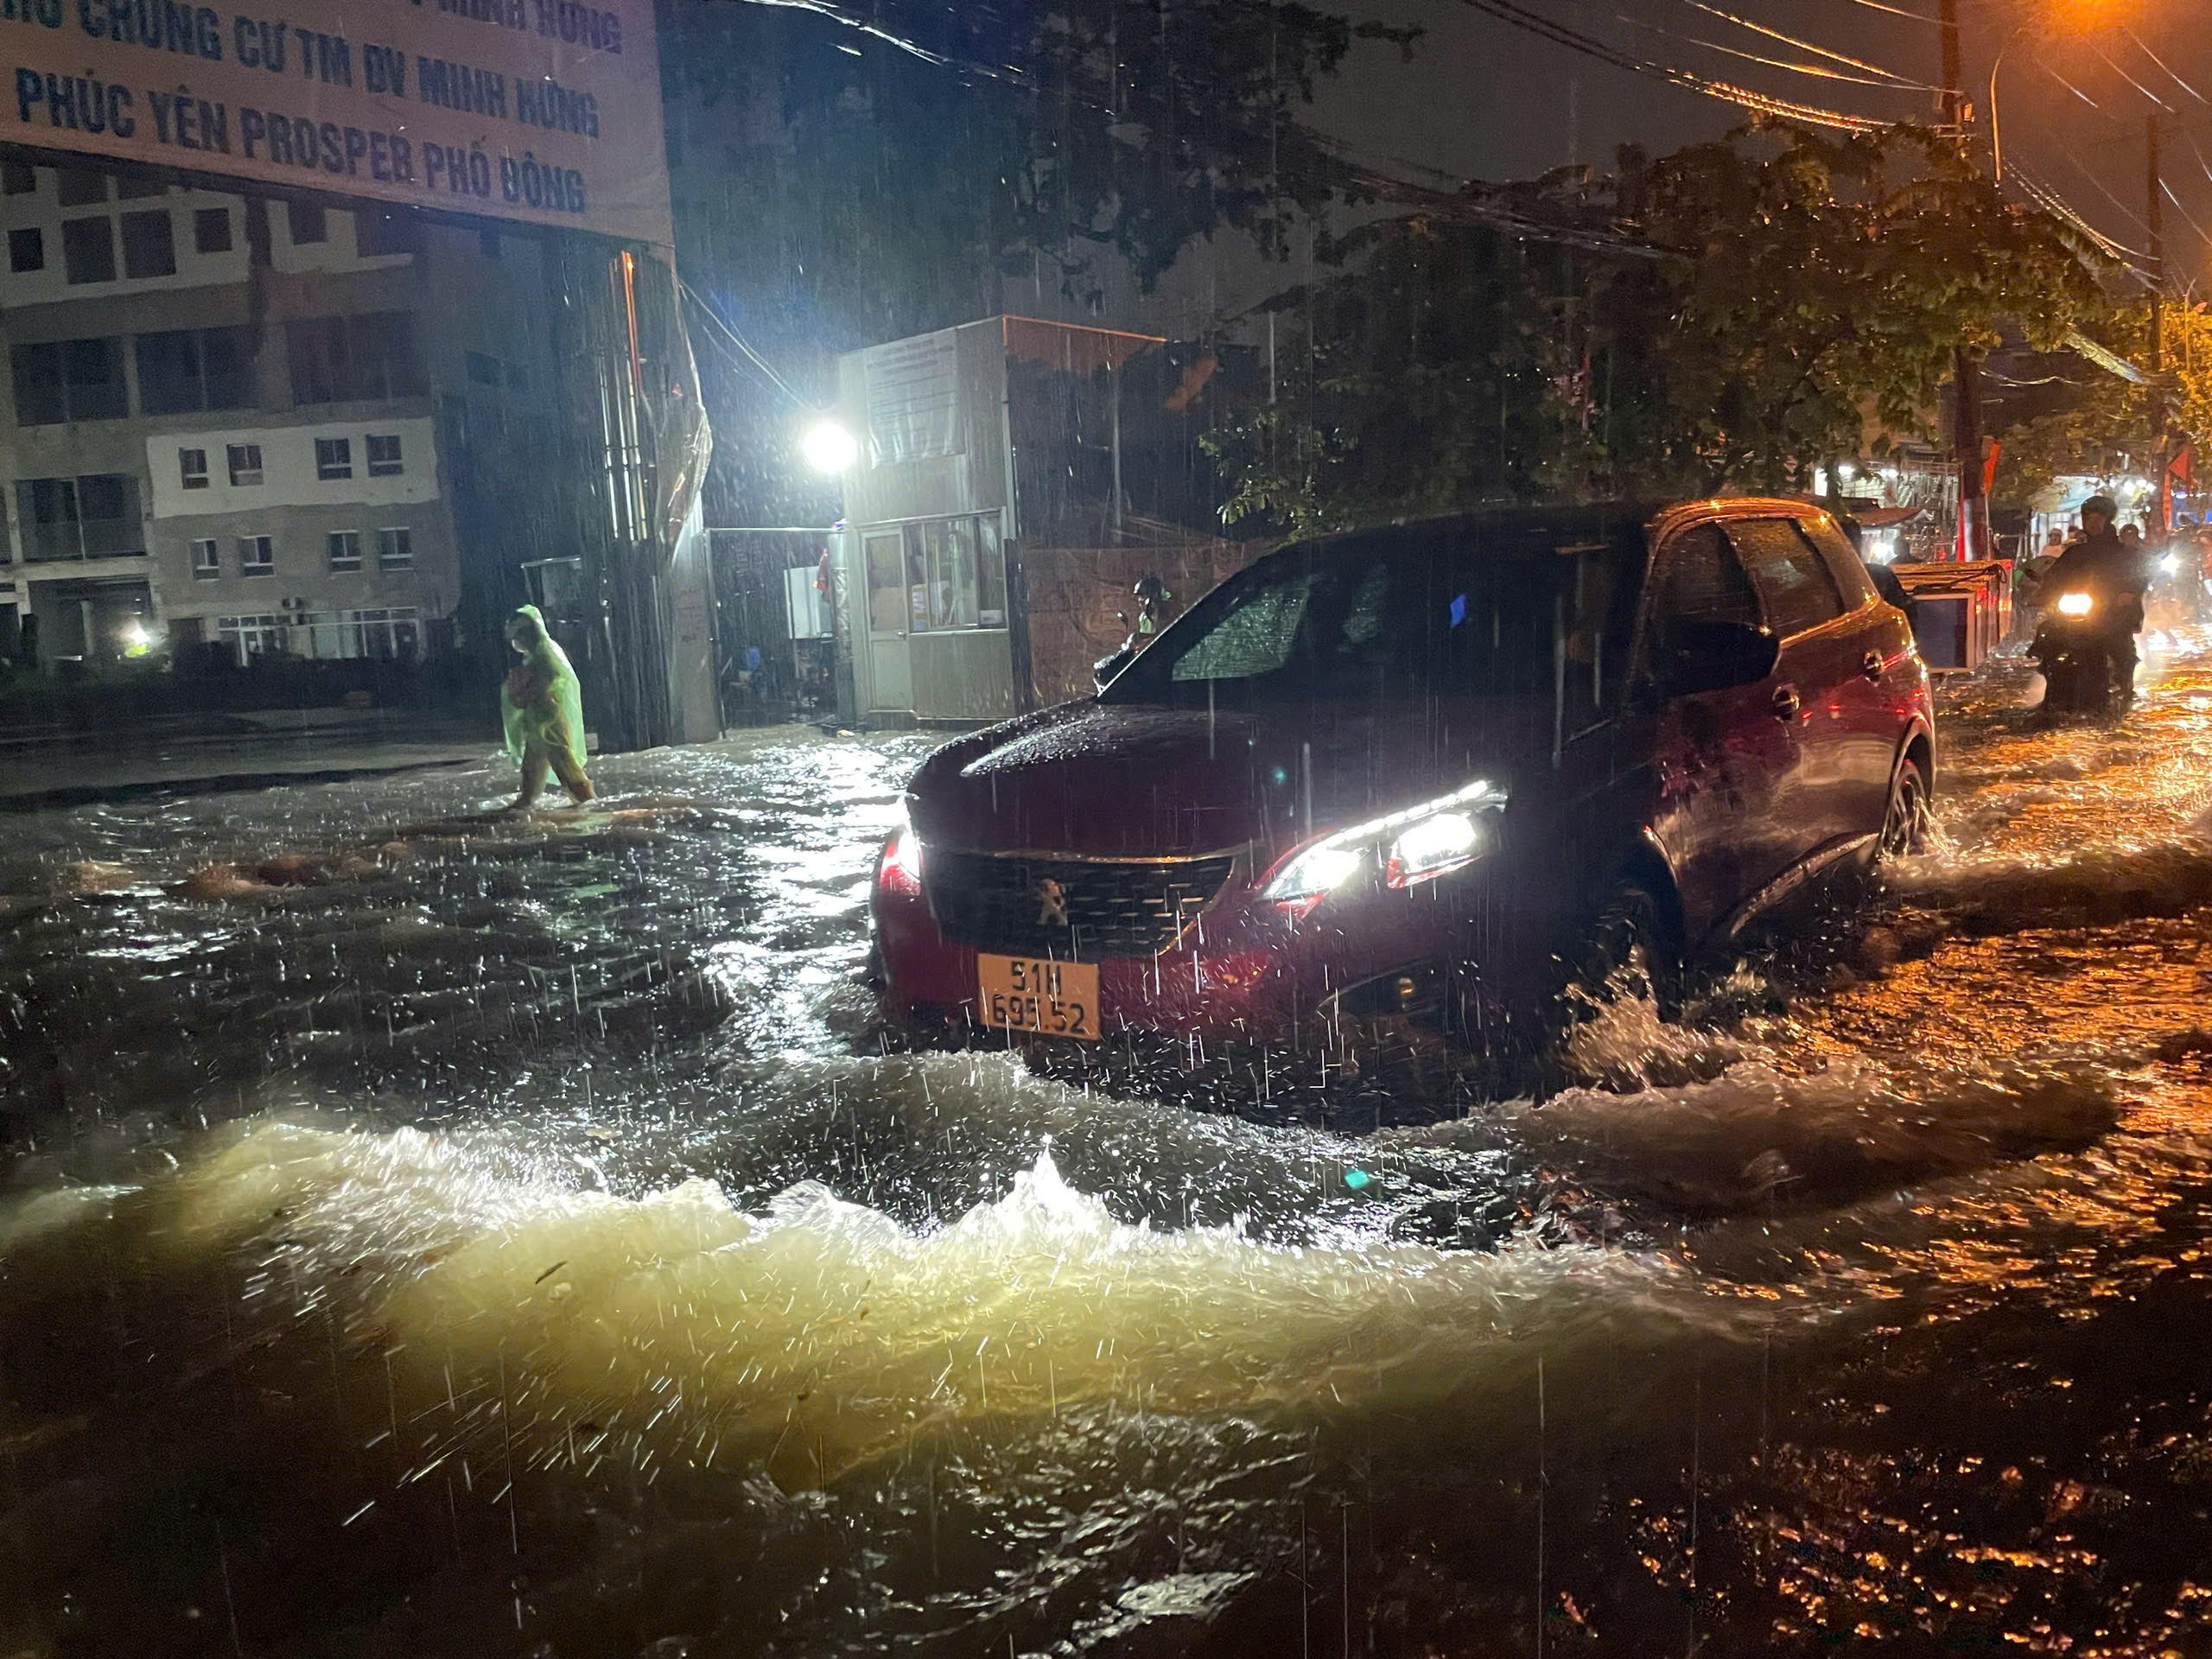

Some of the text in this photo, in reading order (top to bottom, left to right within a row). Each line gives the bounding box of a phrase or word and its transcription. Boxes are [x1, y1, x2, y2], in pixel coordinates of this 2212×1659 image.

[234, 16, 286, 73] CƯ
[418, 54, 506, 119] MINH
[16, 67, 135, 137] PHÚC
[147, 84, 230, 155] YÊN
[239, 105, 414, 181] PROSPER
[423, 135, 491, 199] PHỐ
[1011, 961, 1061, 995] 51H
